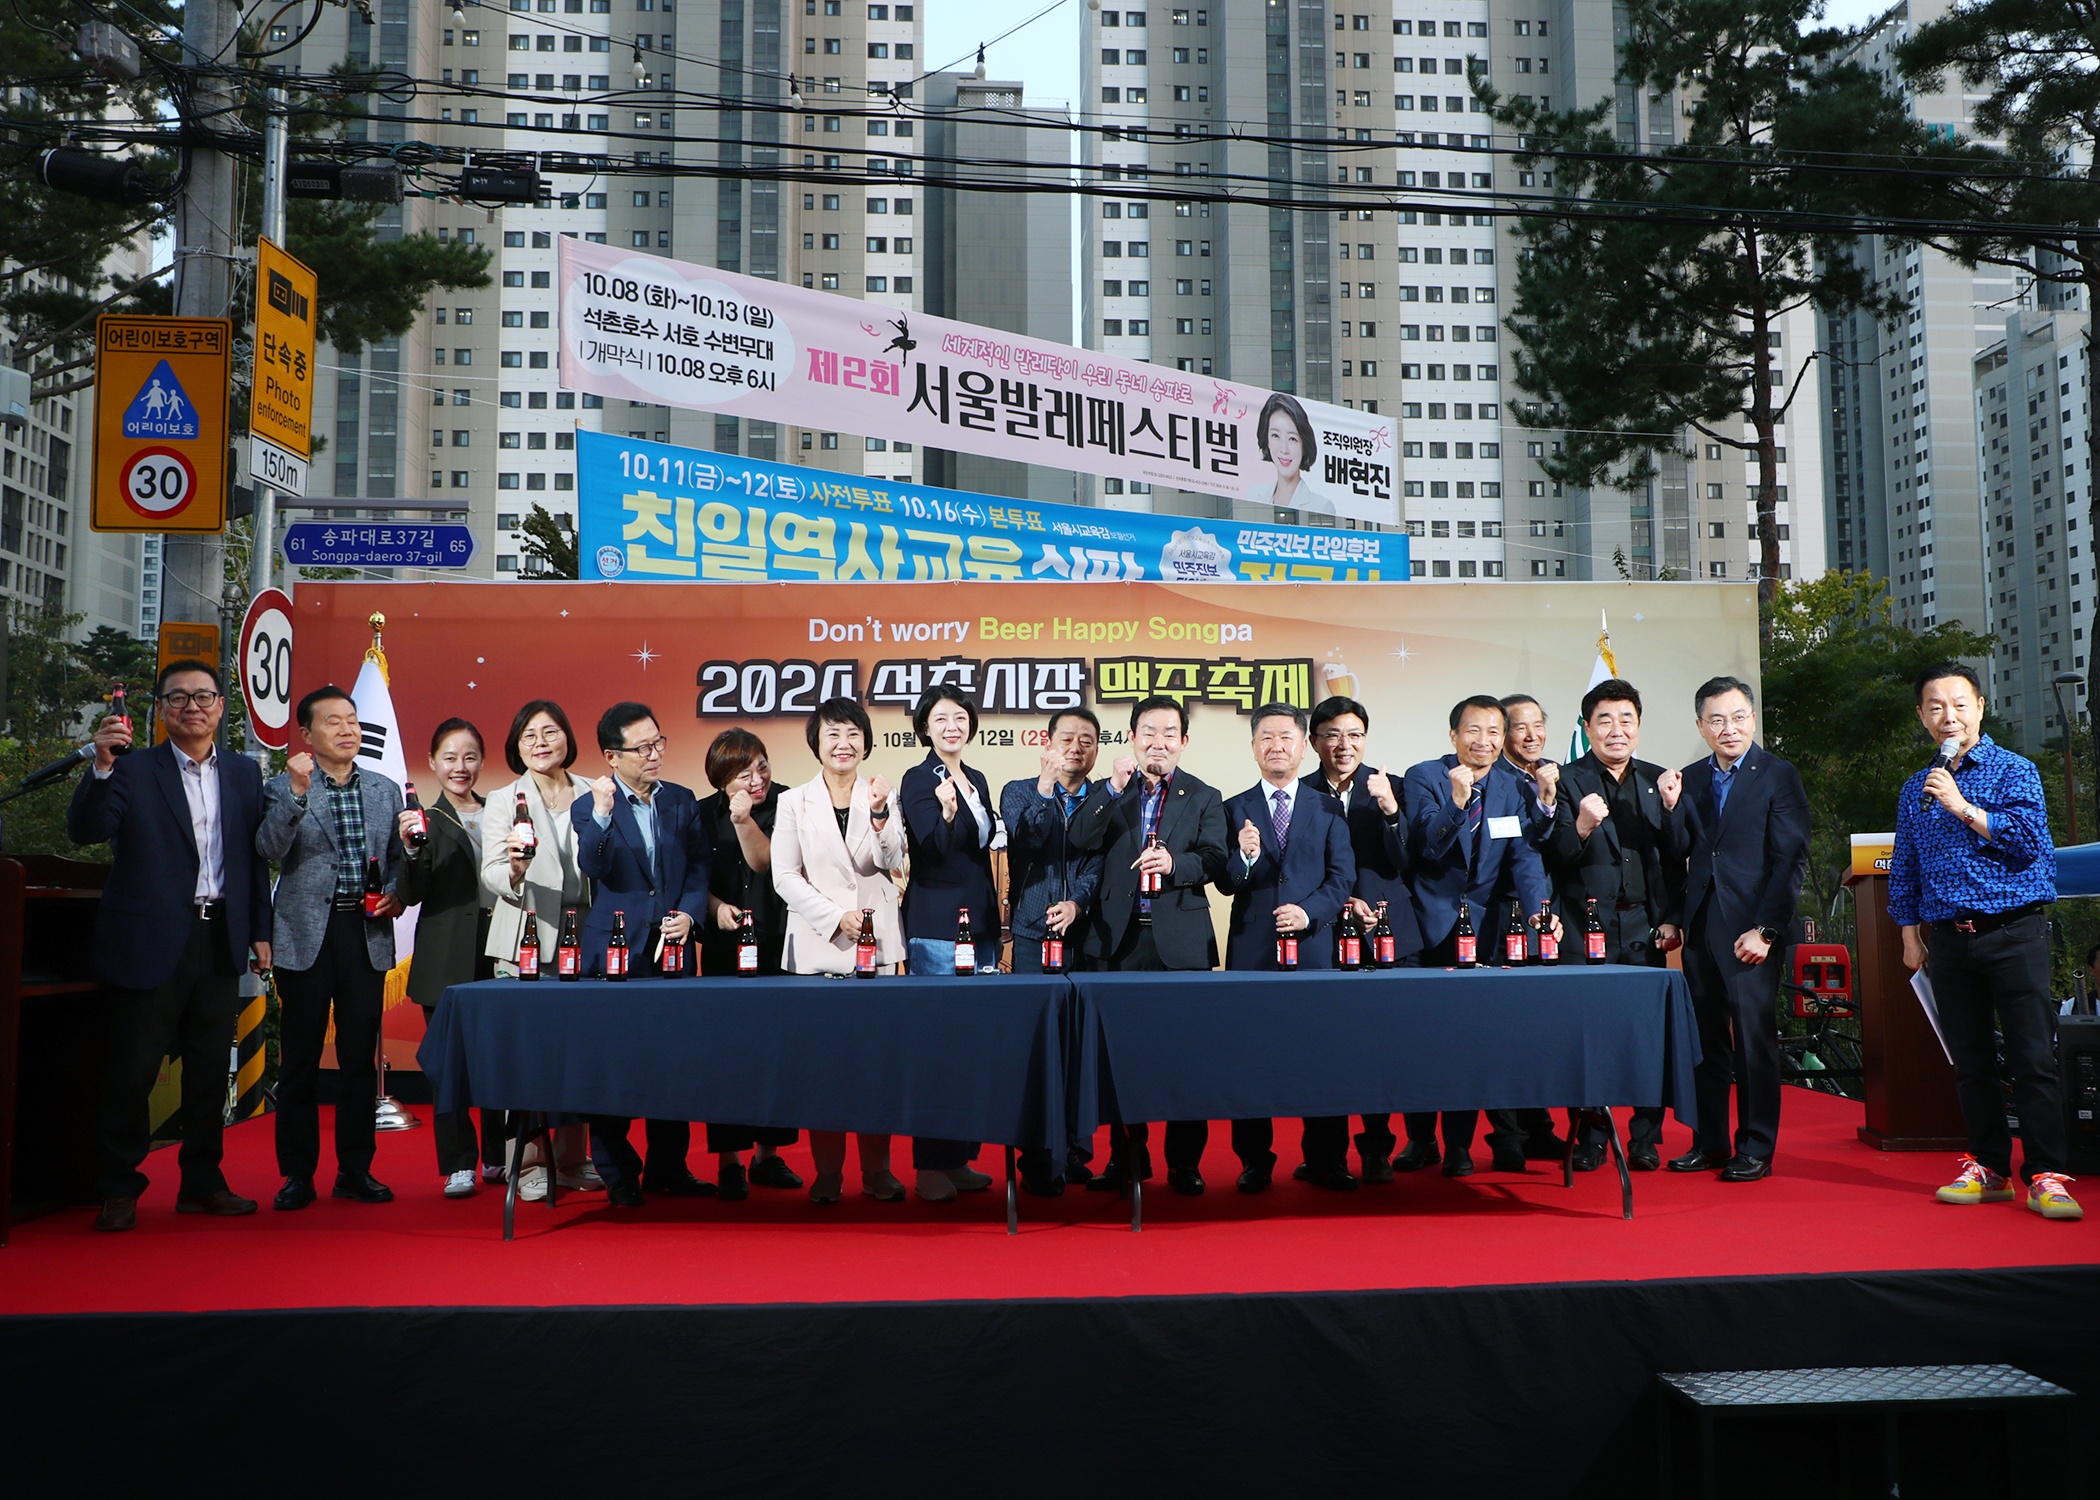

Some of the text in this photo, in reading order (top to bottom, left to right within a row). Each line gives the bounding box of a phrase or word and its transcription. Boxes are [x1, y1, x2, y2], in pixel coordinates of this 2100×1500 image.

[583, 272, 639, 302] 10.08
[743, 304, 774, 329] (일)
[109, 329, 219, 350] 어린이보호구역
[583, 307, 774, 361] 석촌호수 서호 수변무대
[263, 331, 307, 382] 단속중
[656, 353, 705, 379] 10.08
[708, 362, 743, 386] 오후
[747, 369, 776, 392] 6시
[942, 333, 1194, 405] 세계적인 발레단이 우리 동네 송파로
[266, 376, 301, 411] Photo
[257, 401, 306, 438] enforcement
[806, 347, 1240, 477] 제2회 서울발레페스티벌
[1323, 430, 1374, 457] 조직위원장
[135, 465, 183, 500] 30
[262, 448, 298, 488] 150m
[1324, 454, 1391, 500] 배현진
[809, 480, 895, 514] 사전투표
[899, 494, 987, 528] 10.16(수)
[988, 505, 1047, 533] 본투표
[290, 537, 306, 551] 61
[321, 528, 435, 549] 송파대로37길
[450, 540, 466, 553] 65
[1179, 549, 1216, 561] 서울시교육감
[1236, 530, 1311, 559] 민주진보
[1311, 535, 1381, 564] 단일후보
[312, 549, 442, 565] Songpa-daero 37-gil
[1173, 561, 1221, 577] 민주진보
[808, 616, 1253, 645] Don't worry Beer Happy Songpa
[252, 631, 292, 705] 30
[701, 664, 857, 713] 2024
[1100, 661, 1311, 710] 맥주축제
[883, 732, 917, 748] 10월
[978, 729, 1014, 747] 12일
